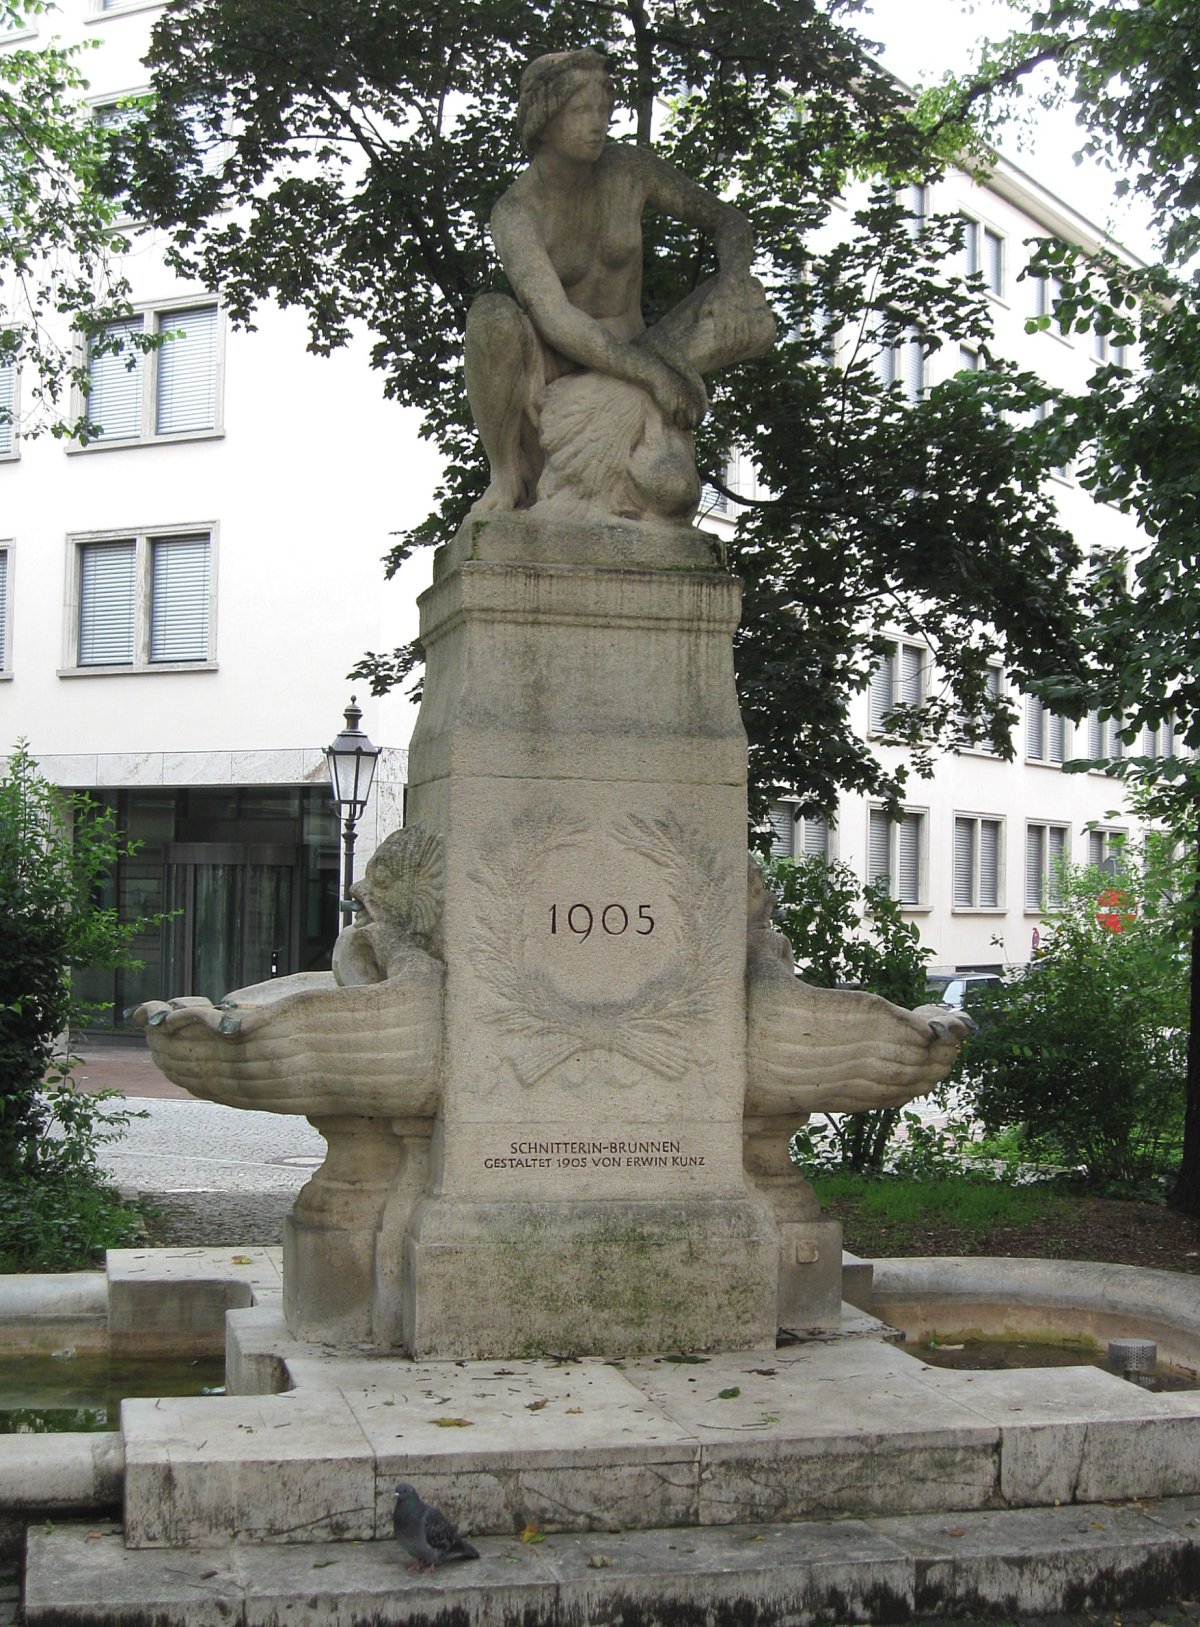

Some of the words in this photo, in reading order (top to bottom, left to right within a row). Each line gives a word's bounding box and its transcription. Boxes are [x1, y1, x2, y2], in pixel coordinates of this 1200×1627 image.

[548, 903, 655, 944] 1905
[510, 1141, 681, 1154] SCHNITTERIN-BRUNNEN
[484, 1157, 552, 1169] GESTALTET
[556, 1157, 587, 1168] 1905
[593, 1156, 621, 1168] VON
[626, 1156, 668, 1167] ERWIN
[671, 1155, 706, 1167] KUNZ
